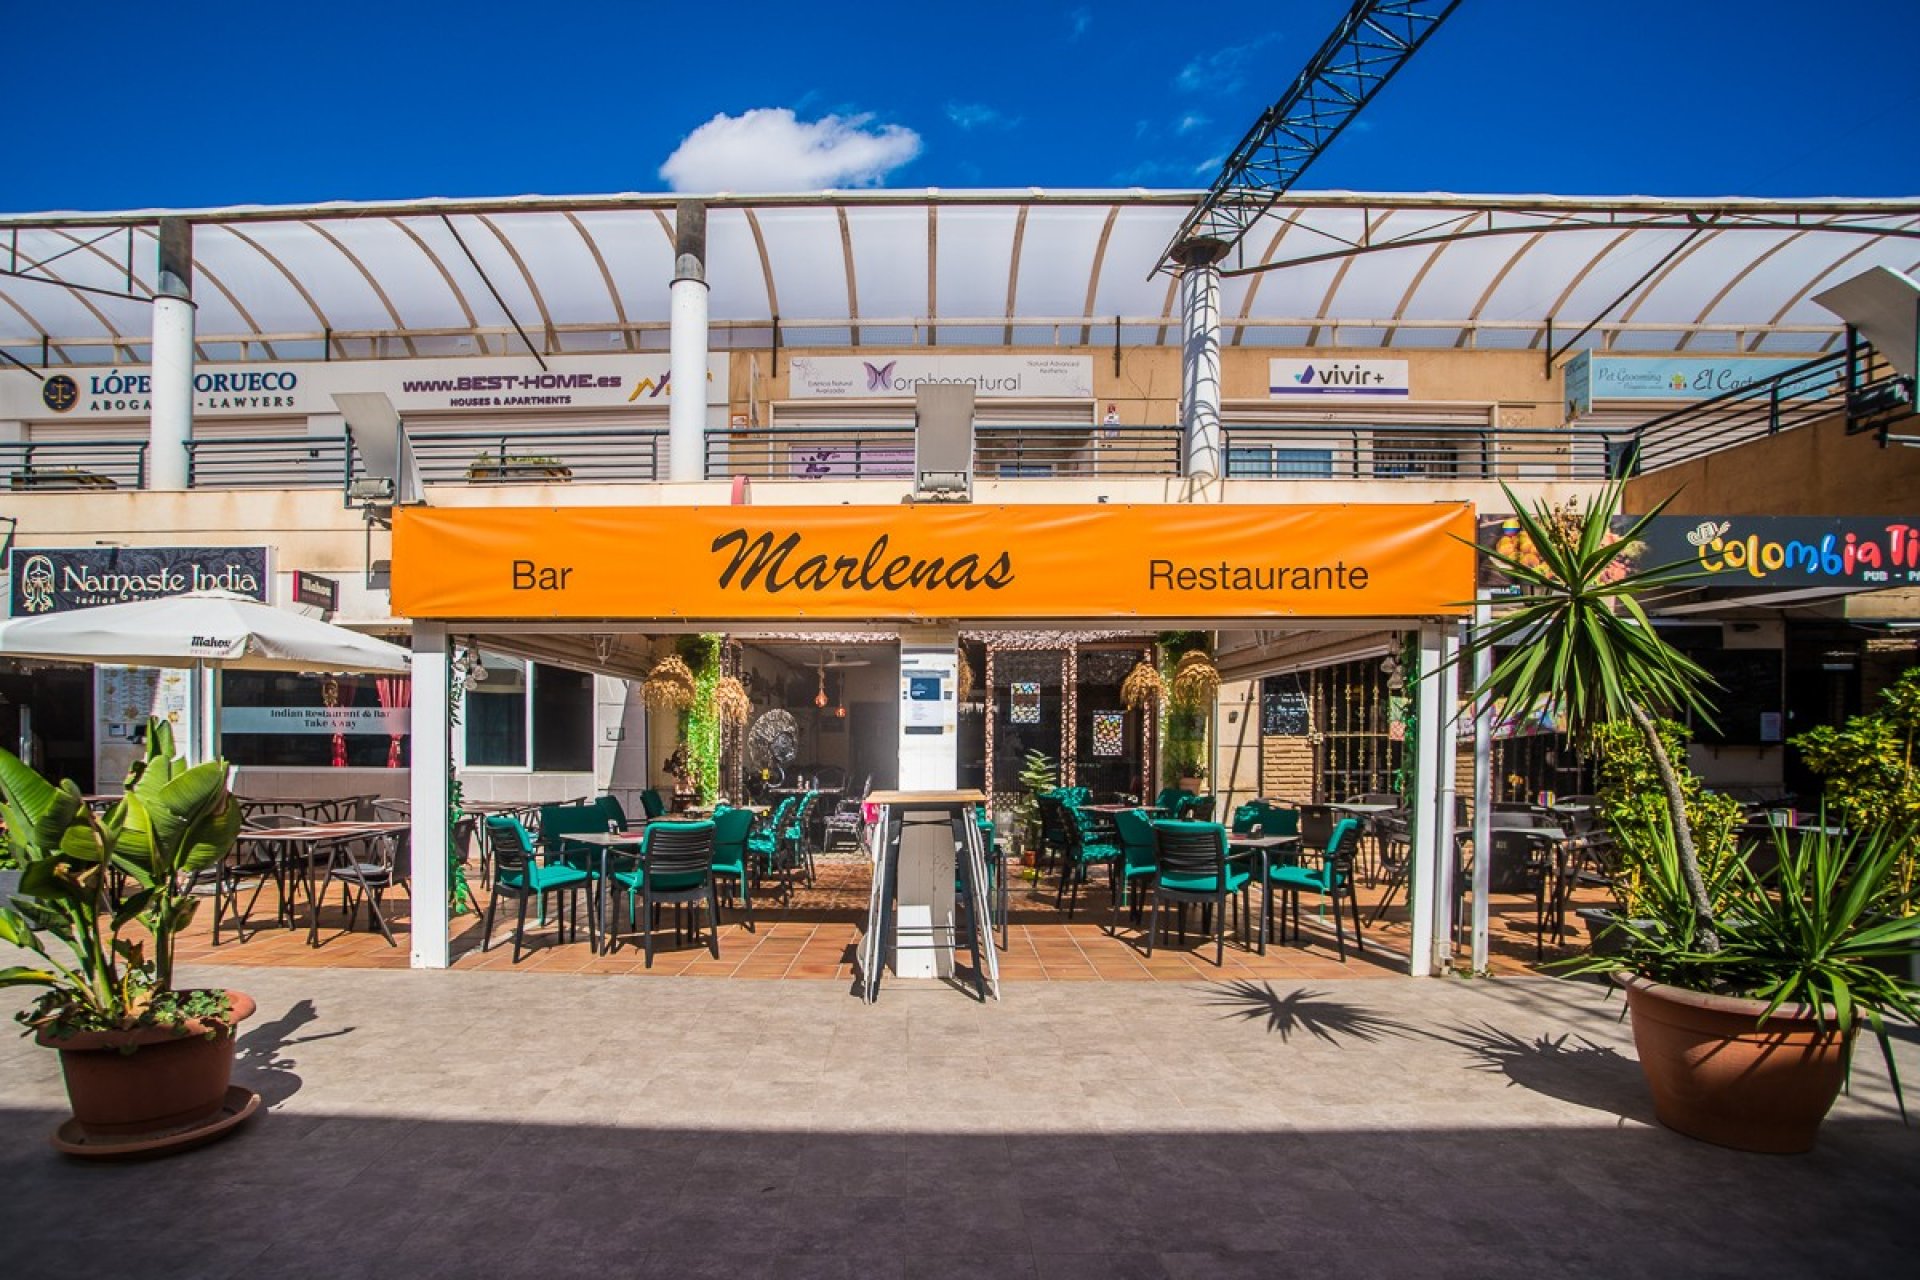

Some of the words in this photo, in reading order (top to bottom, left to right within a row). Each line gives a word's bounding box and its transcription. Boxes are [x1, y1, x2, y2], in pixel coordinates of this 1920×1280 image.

[91, 369, 152, 394] LÓPE
[193, 373, 297, 393] ORUECO
[1692, 368, 1714, 391] El
[91, 400, 152, 410] ABOGA
[450, 397, 491, 406] HOUSES
[494, 396, 501, 405] &
[503, 395, 572, 406] APARTMENTS
[1698, 533, 1883, 578] Colombia
[1885, 524, 1920, 569] Ti
[512, 560, 573, 590] Bar
[711, 529, 1015, 593] Marlenas
[1149, 560, 1369, 590] Restaurante
[62, 565, 185, 600] Namaste
[192, 564, 257, 591] India
[76, 595, 116, 604] Indian
[271, 709, 303, 718] Indian
[305, 709, 360, 718] Restaurant
[362, 709, 371, 718] &
[305, 718, 329, 728] Take
